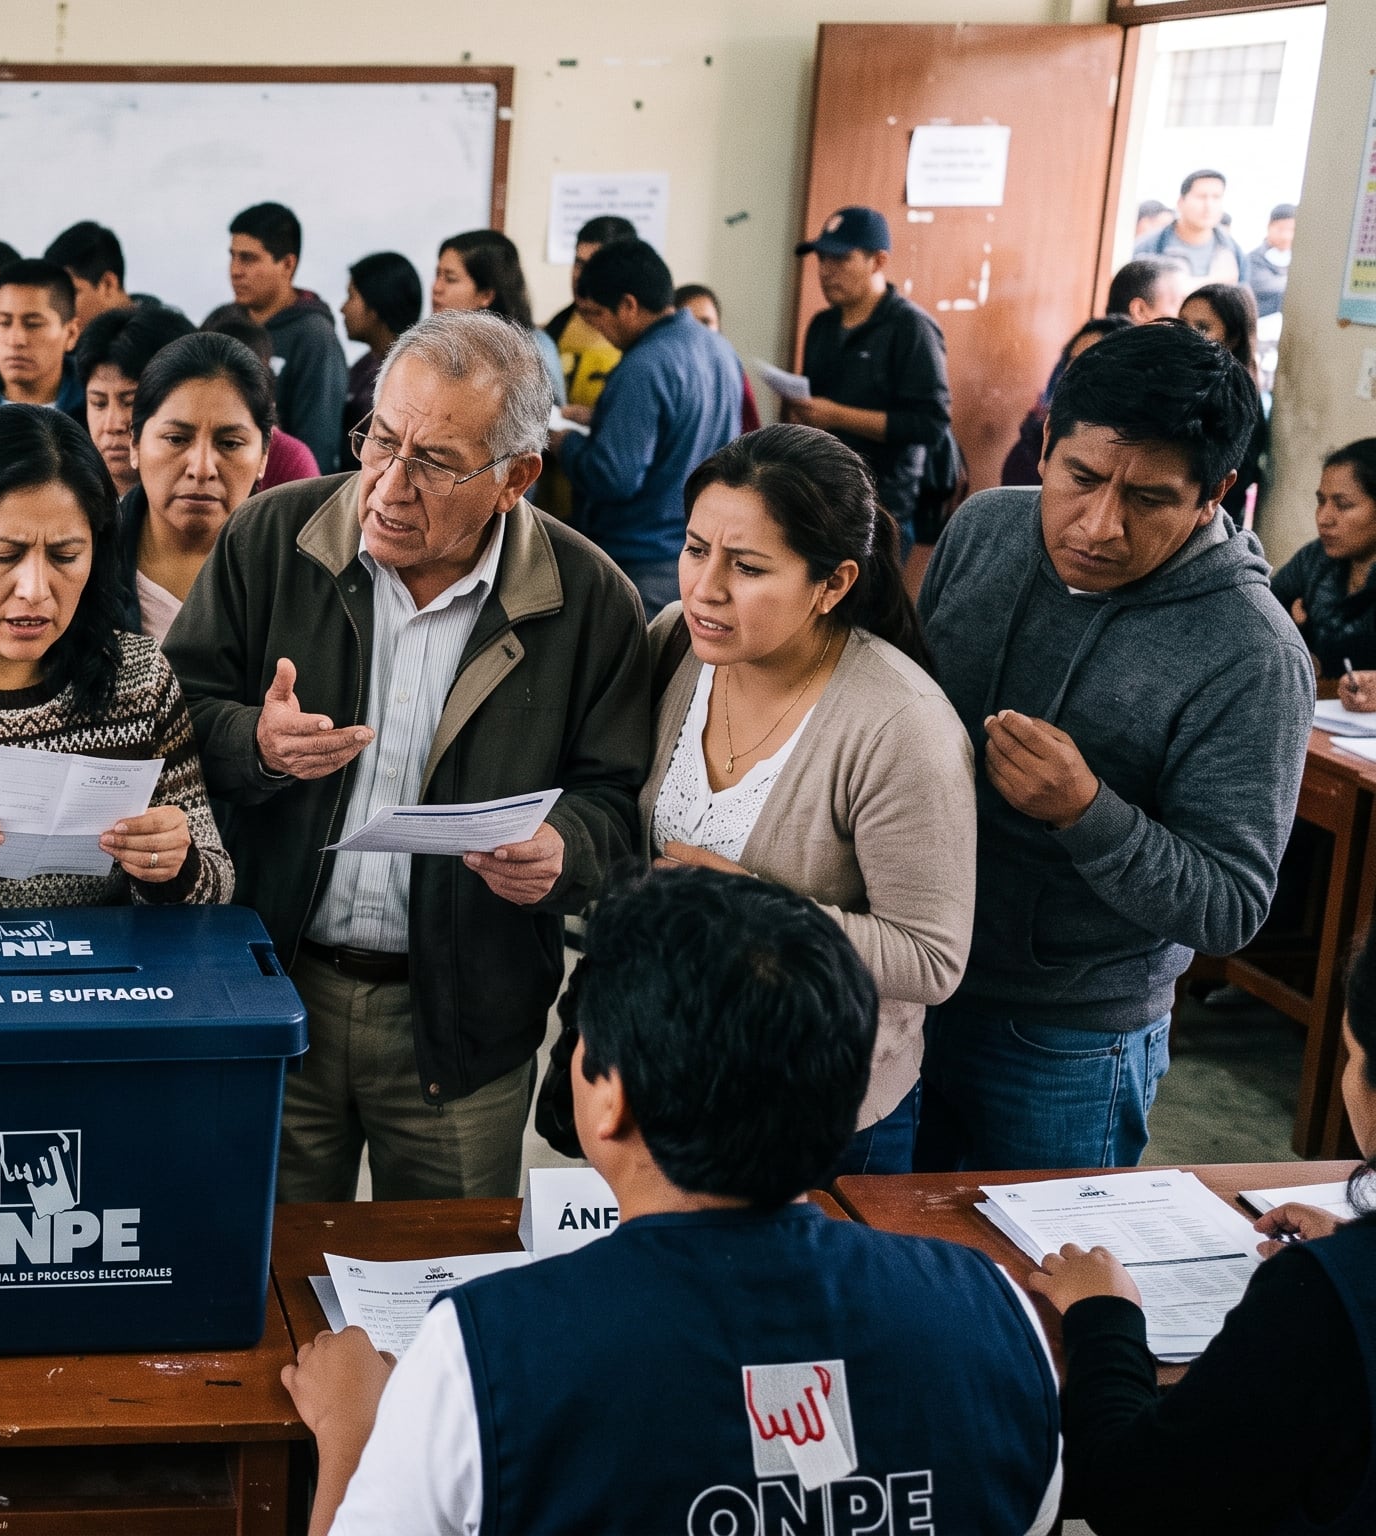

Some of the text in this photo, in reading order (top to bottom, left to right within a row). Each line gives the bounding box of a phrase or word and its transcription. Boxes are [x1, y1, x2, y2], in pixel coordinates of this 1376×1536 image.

[11, 989, 43, 1003] DE
[49, 987, 174, 1002] SUFRAGIO
[19, 1271, 34, 1282] DE
[37, 1270, 95, 1281] PROCESOS
[99, 1268, 172, 1279] ELECTORALES
[687, 1470, 935, 1536] ONPE
